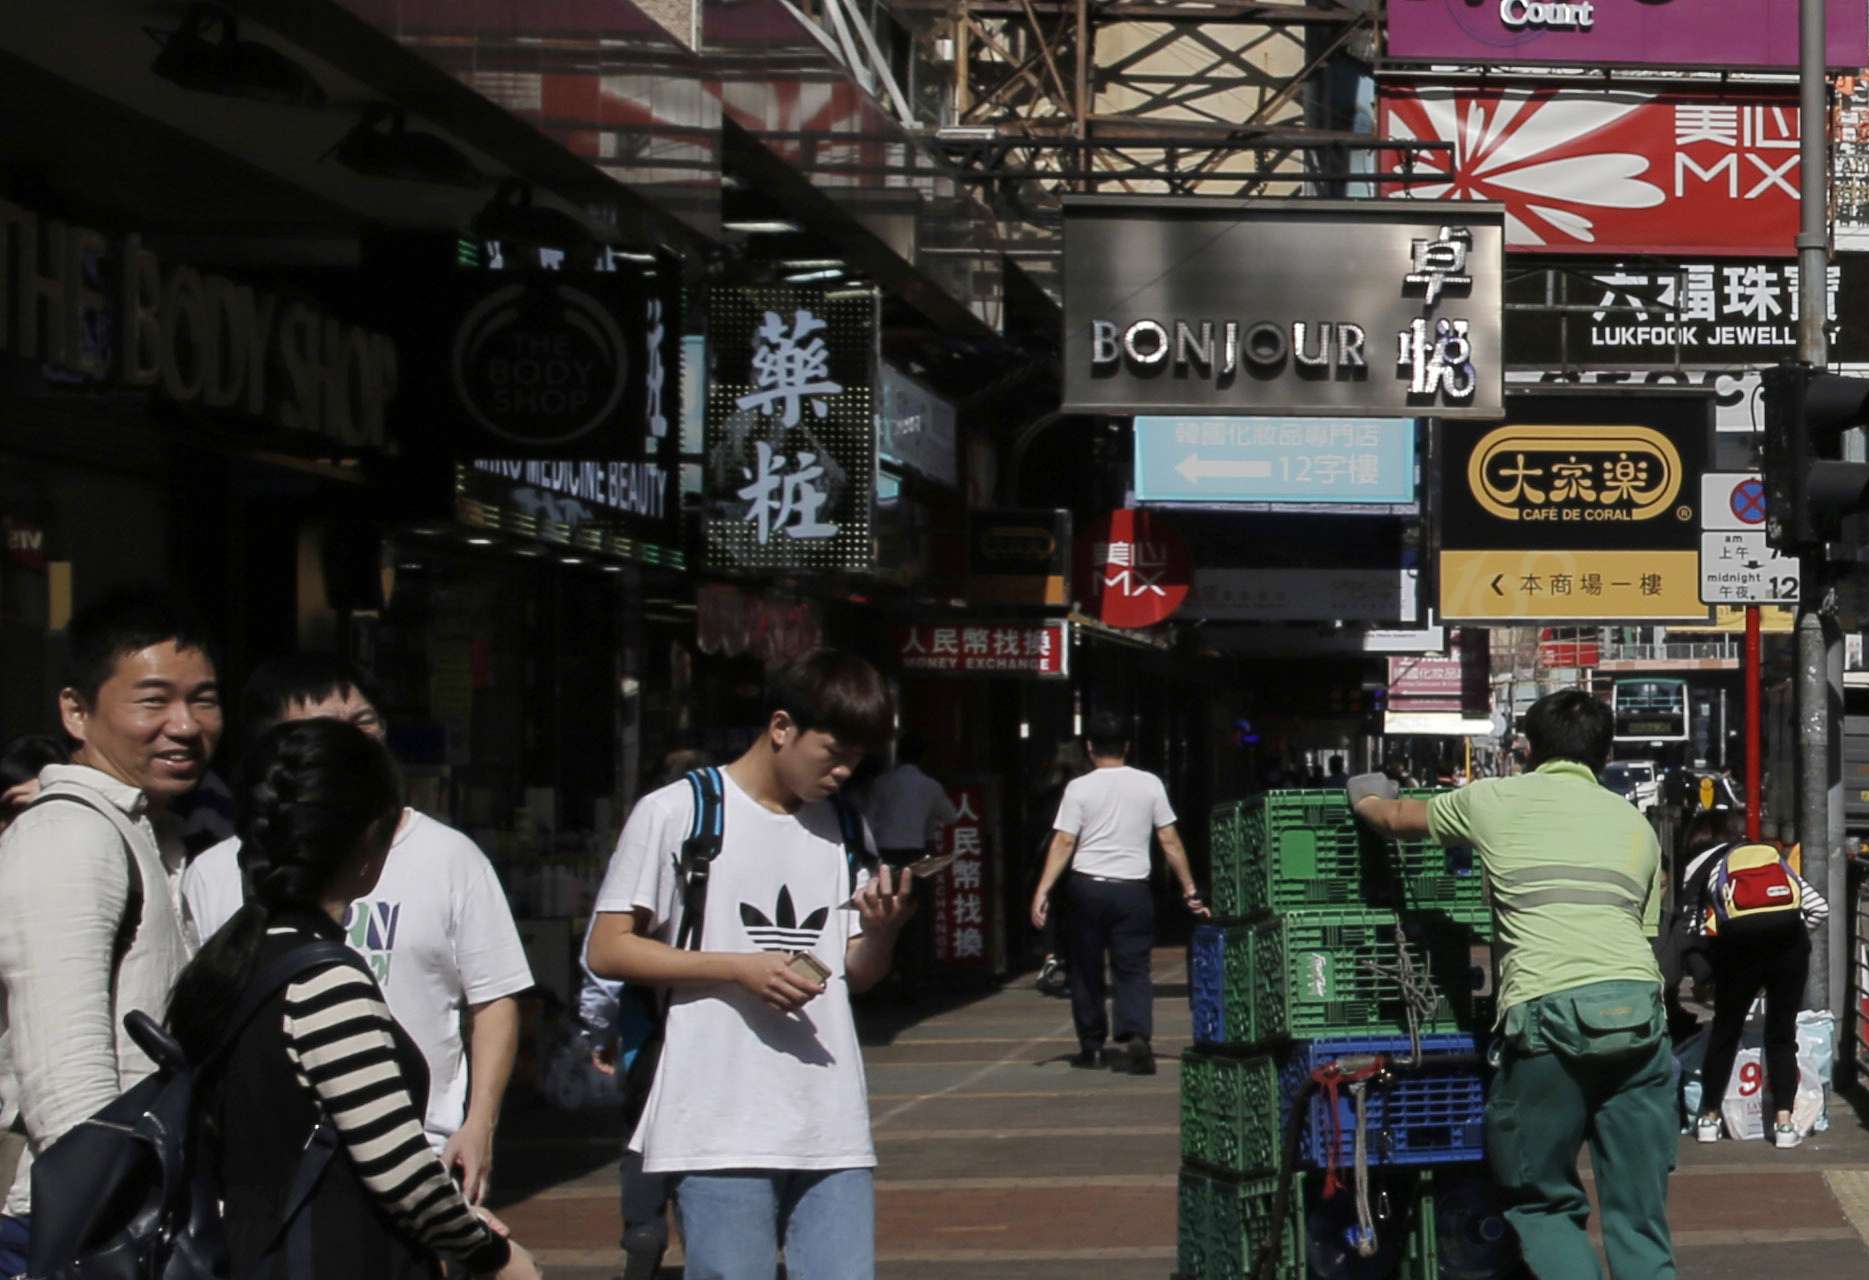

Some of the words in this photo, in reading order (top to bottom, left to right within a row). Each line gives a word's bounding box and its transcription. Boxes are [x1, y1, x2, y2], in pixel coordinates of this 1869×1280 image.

[1675, 152, 1801, 200] MX
[1091, 322, 1367, 376] BONJOUR
[1592, 326, 1698, 346] LUKFOOK
[488, 360, 594, 386] BODY
[493, 390, 590, 417] SHOP
[1562, 508, 1581, 521] DE
[1585, 508, 1631, 521] CORAL
[1725, 535, 1742, 543] am
[1719, 546, 1749, 560] 上午
[1091, 570, 1168, 598] MX
[1520, 573, 1664, 598] 本商場一樓
[1707, 571, 1761, 585] midnight
[1768, 576, 1798, 600] 12
[1719, 585, 1749, 600] 午夜
[902, 625, 1052, 657] 人民幣找換
[965, 657, 1050, 671] EXCHANGE
[953, 792, 984, 961] 人民幣找換
